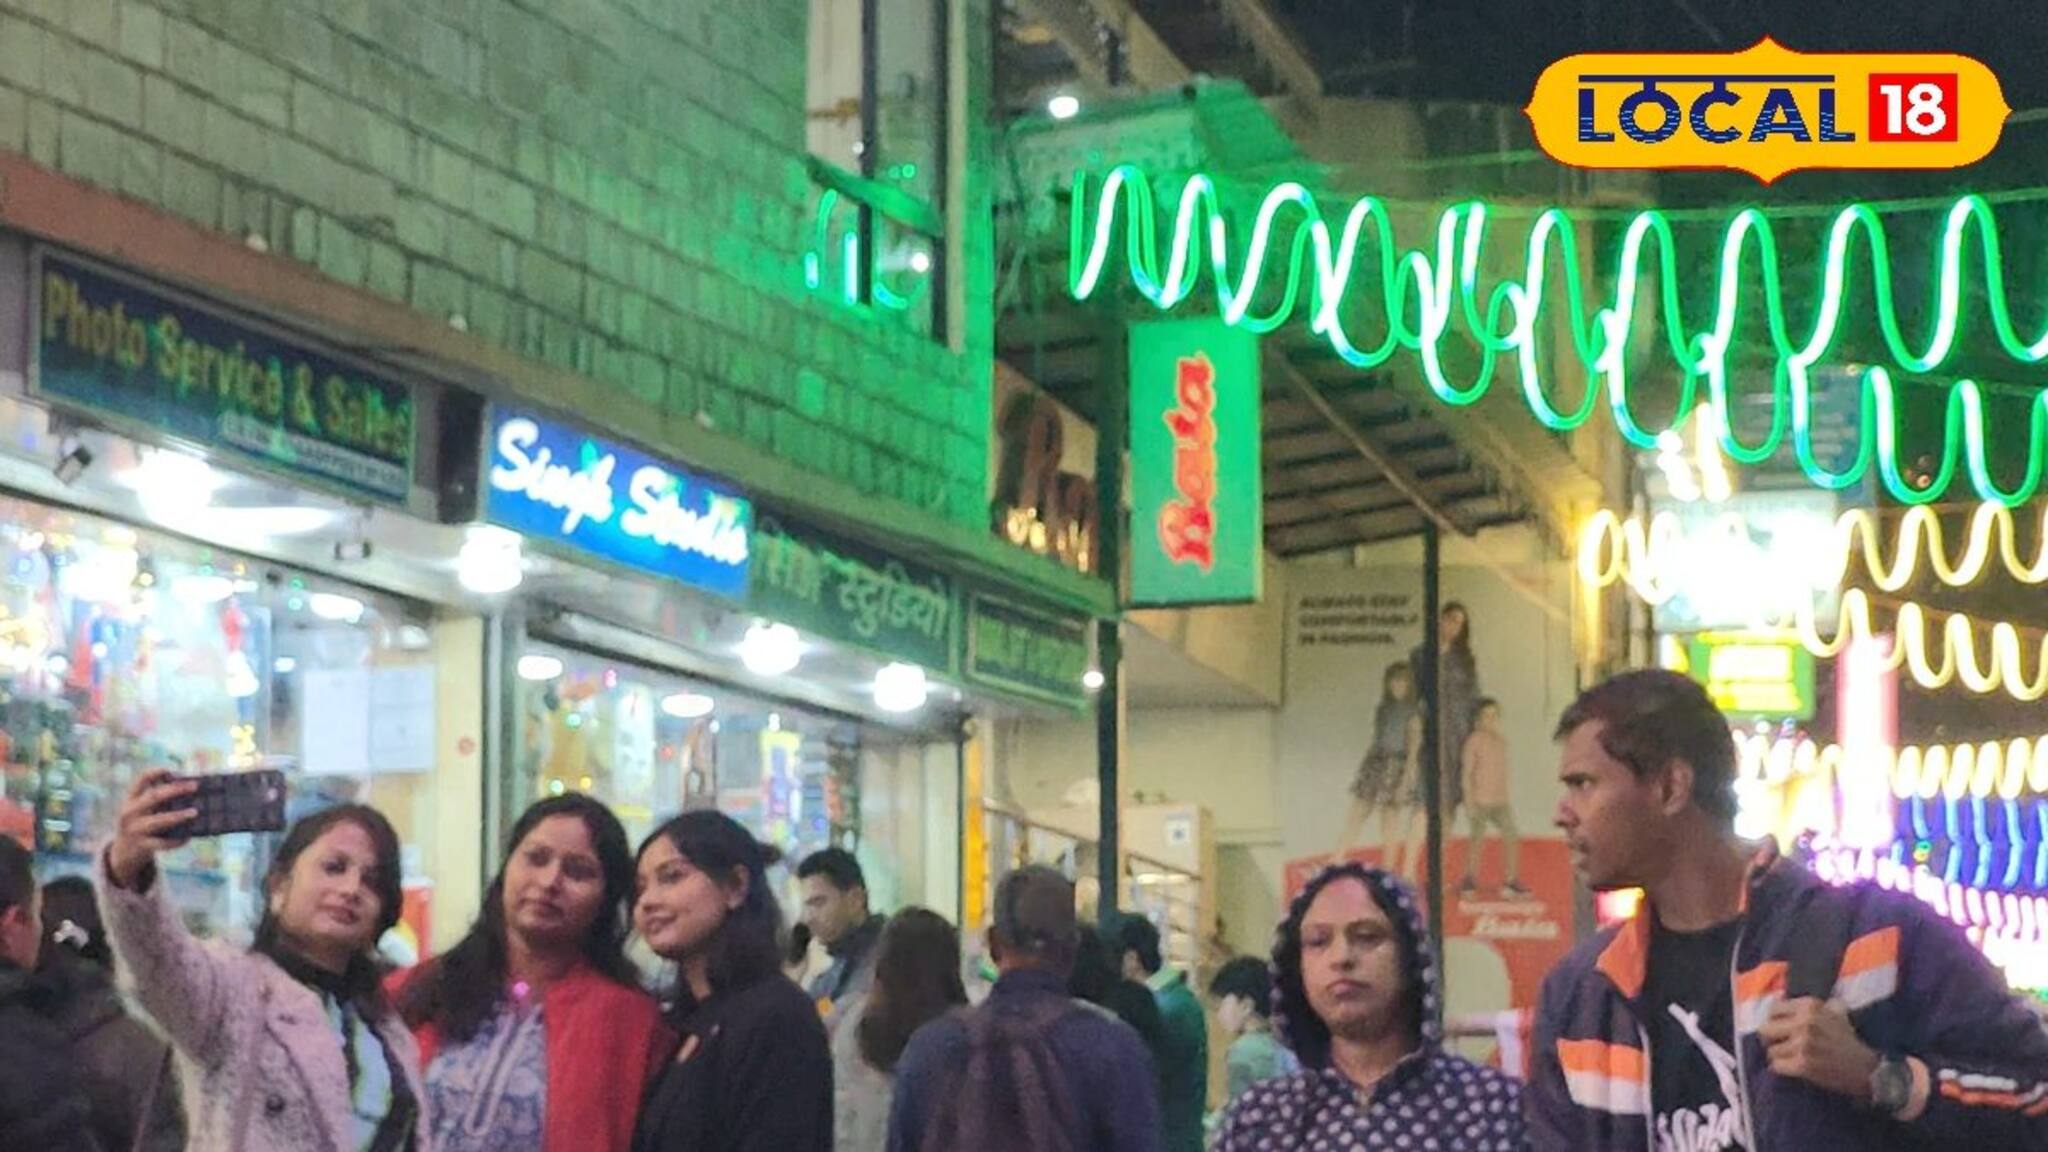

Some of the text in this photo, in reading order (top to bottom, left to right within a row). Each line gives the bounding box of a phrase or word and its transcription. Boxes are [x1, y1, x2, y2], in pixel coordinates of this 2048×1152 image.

[43, 270, 148, 369] Photo
[155, 313, 284, 418] Service
[291, 362, 321, 434] &
